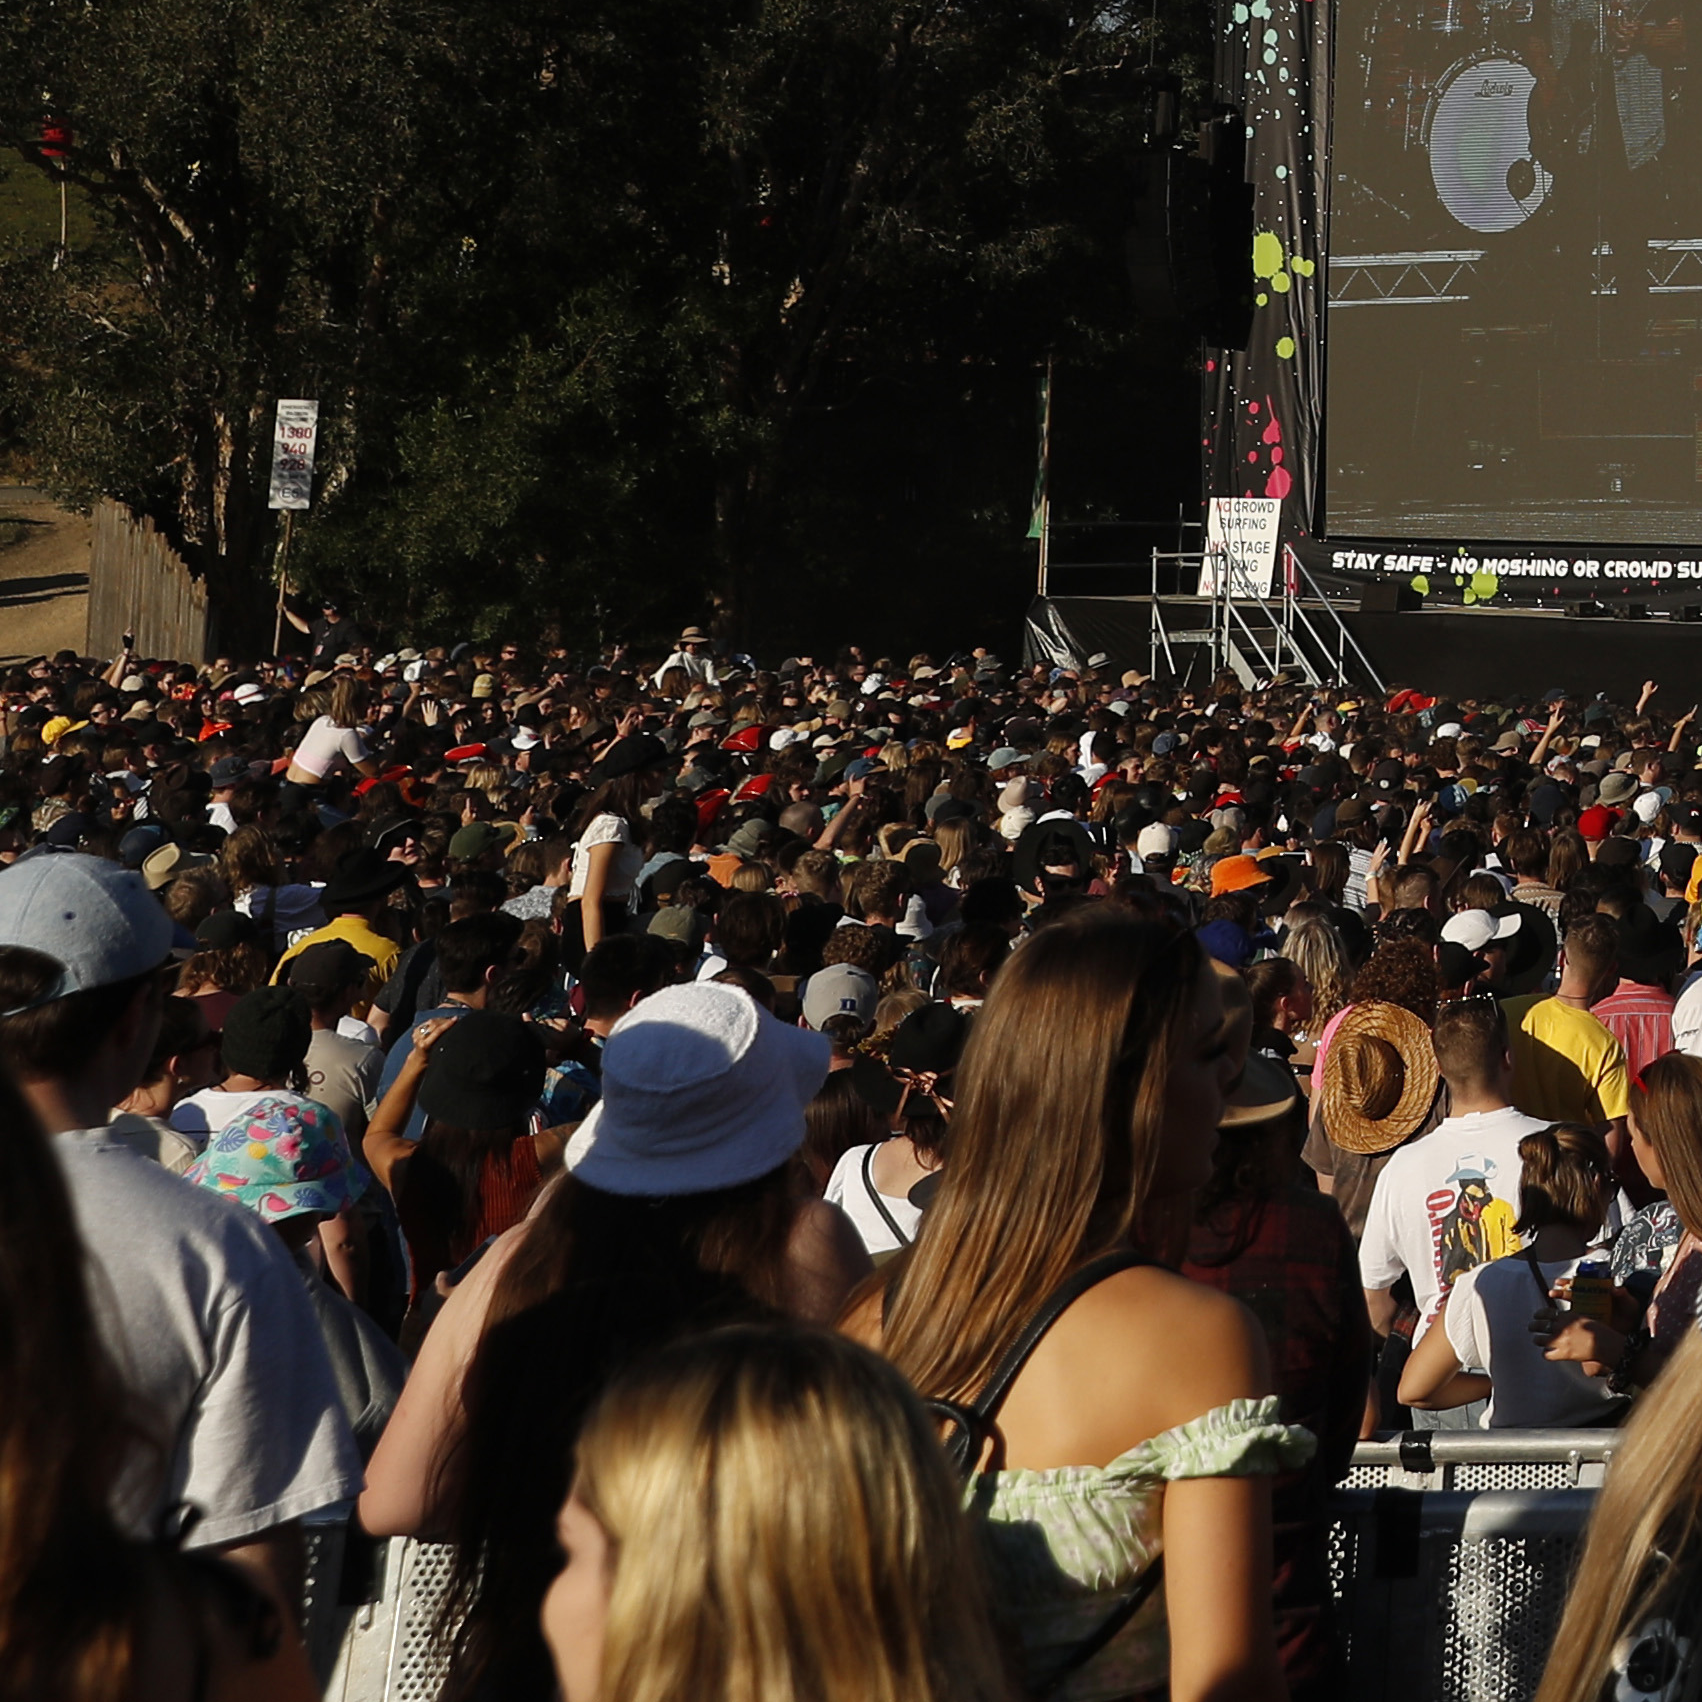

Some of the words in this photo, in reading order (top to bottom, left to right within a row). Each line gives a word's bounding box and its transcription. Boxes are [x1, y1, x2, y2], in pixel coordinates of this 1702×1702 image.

[281, 442, 308, 456] 940
[279, 458, 306, 471] 928
[1215, 501, 1231, 513] NO
[1234, 501, 1275, 514] CROWD
[1220, 518, 1267, 530] SURFING
[1232, 541, 1271, 554] STAGE
[1332, 550, 1381, 570] STAY
[1383, 554, 1435, 573] SAFE
[1450, 557, 1479, 574] NO
[1481, 558, 1569, 577] MOSHING
[1573, 560, 1600, 578] OR
[1604, 560, 1673, 579] CROWD
